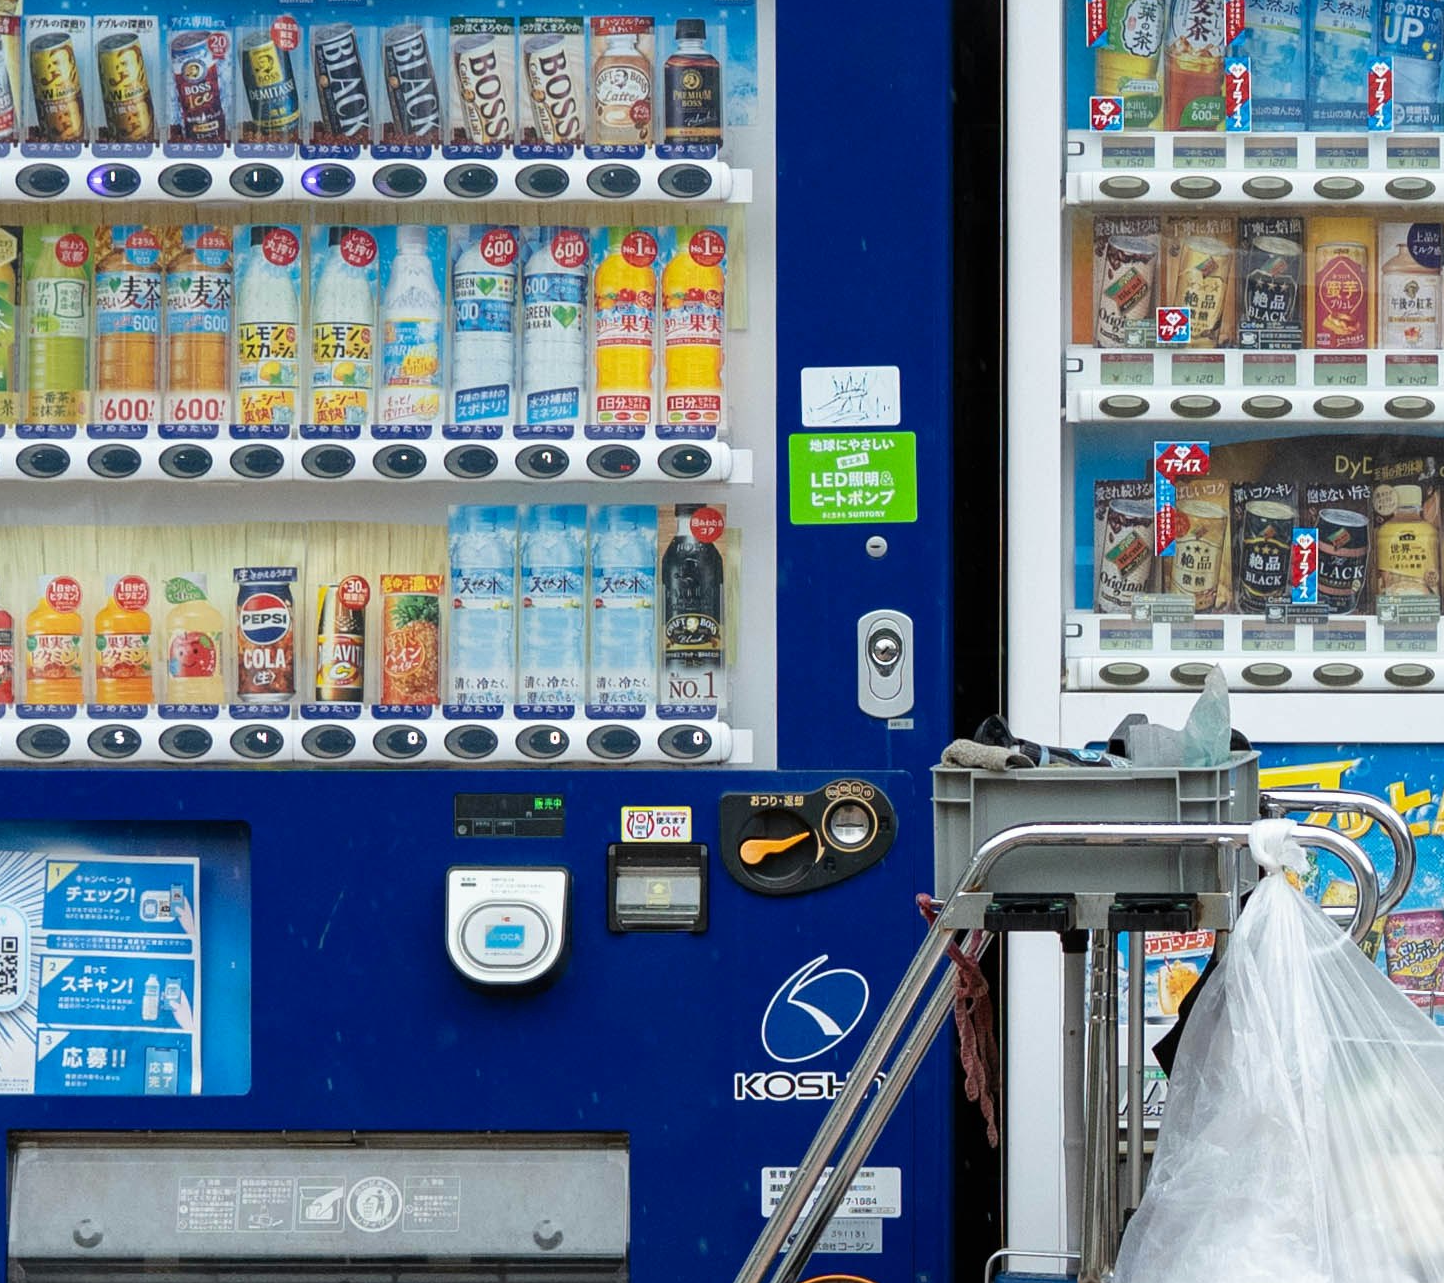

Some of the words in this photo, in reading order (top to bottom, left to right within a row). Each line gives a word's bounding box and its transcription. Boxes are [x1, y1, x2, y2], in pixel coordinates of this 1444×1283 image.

[1384, 2, 1430, 18] SPORTS
[1132, 2, 1156, 51] 葉の茶
[1383, 16, 1423, 45] UP
[321, 34, 360, 137] BLACK
[393, 34, 440, 137] BLACK
[602, 89, 638, 103] Latte
[672, 91, 712, 101] PREMIUM
[1412, 230, 1438, 243] 上品な
[484, 240, 514, 257] 600
[555, 241, 584, 258] 600
[61, 251, 84, 264] 京都
[120, 276, 162, 309] 麦茶
[190, 276, 232, 309] 麦茶
[1326, 281, 1361, 298] 蜜芋
[1184, 290, 1216, 310] 絶品
[1253, 292, 1285, 310] 絶品
[1390, 297, 1434, 310] 午後の紅茶
[525, 307, 551, 319] GREEN
[320, 325, 360, 342] レモン
[320, 342, 372, 360] スカッシュ
[809, 438, 895, 451] 地球にやさしい
[811, 490, 896, 507] ヒートポンプ
[462, 577, 503, 595] 天然水
[530, 577, 573, 595] 天然水
[1182, 573, 1206, 586] 微糖
[242, 614, 287, 626] PEPSI
[243, 649, 286, 670] COLA
[385, 646, 422, 666] パイン
[668, 673, 718, 700] NO.1
[534, 798, 563, 811] 販売中
[750, 795, 804, 807] おつり・返却
[656, 815, 687, 825] 使えます
[660, 826, 682, 838] OK
[76, 874, 132, 884] キャンペーンを
[66, 886, 136, 903] チェック!
[84, 966, 108, 974] 買って
[62, 977, 133, 994] スキャン!
[62, 1047, 127, 1069] 応募!!
[838, 1242, 874, 1251] コーシン
